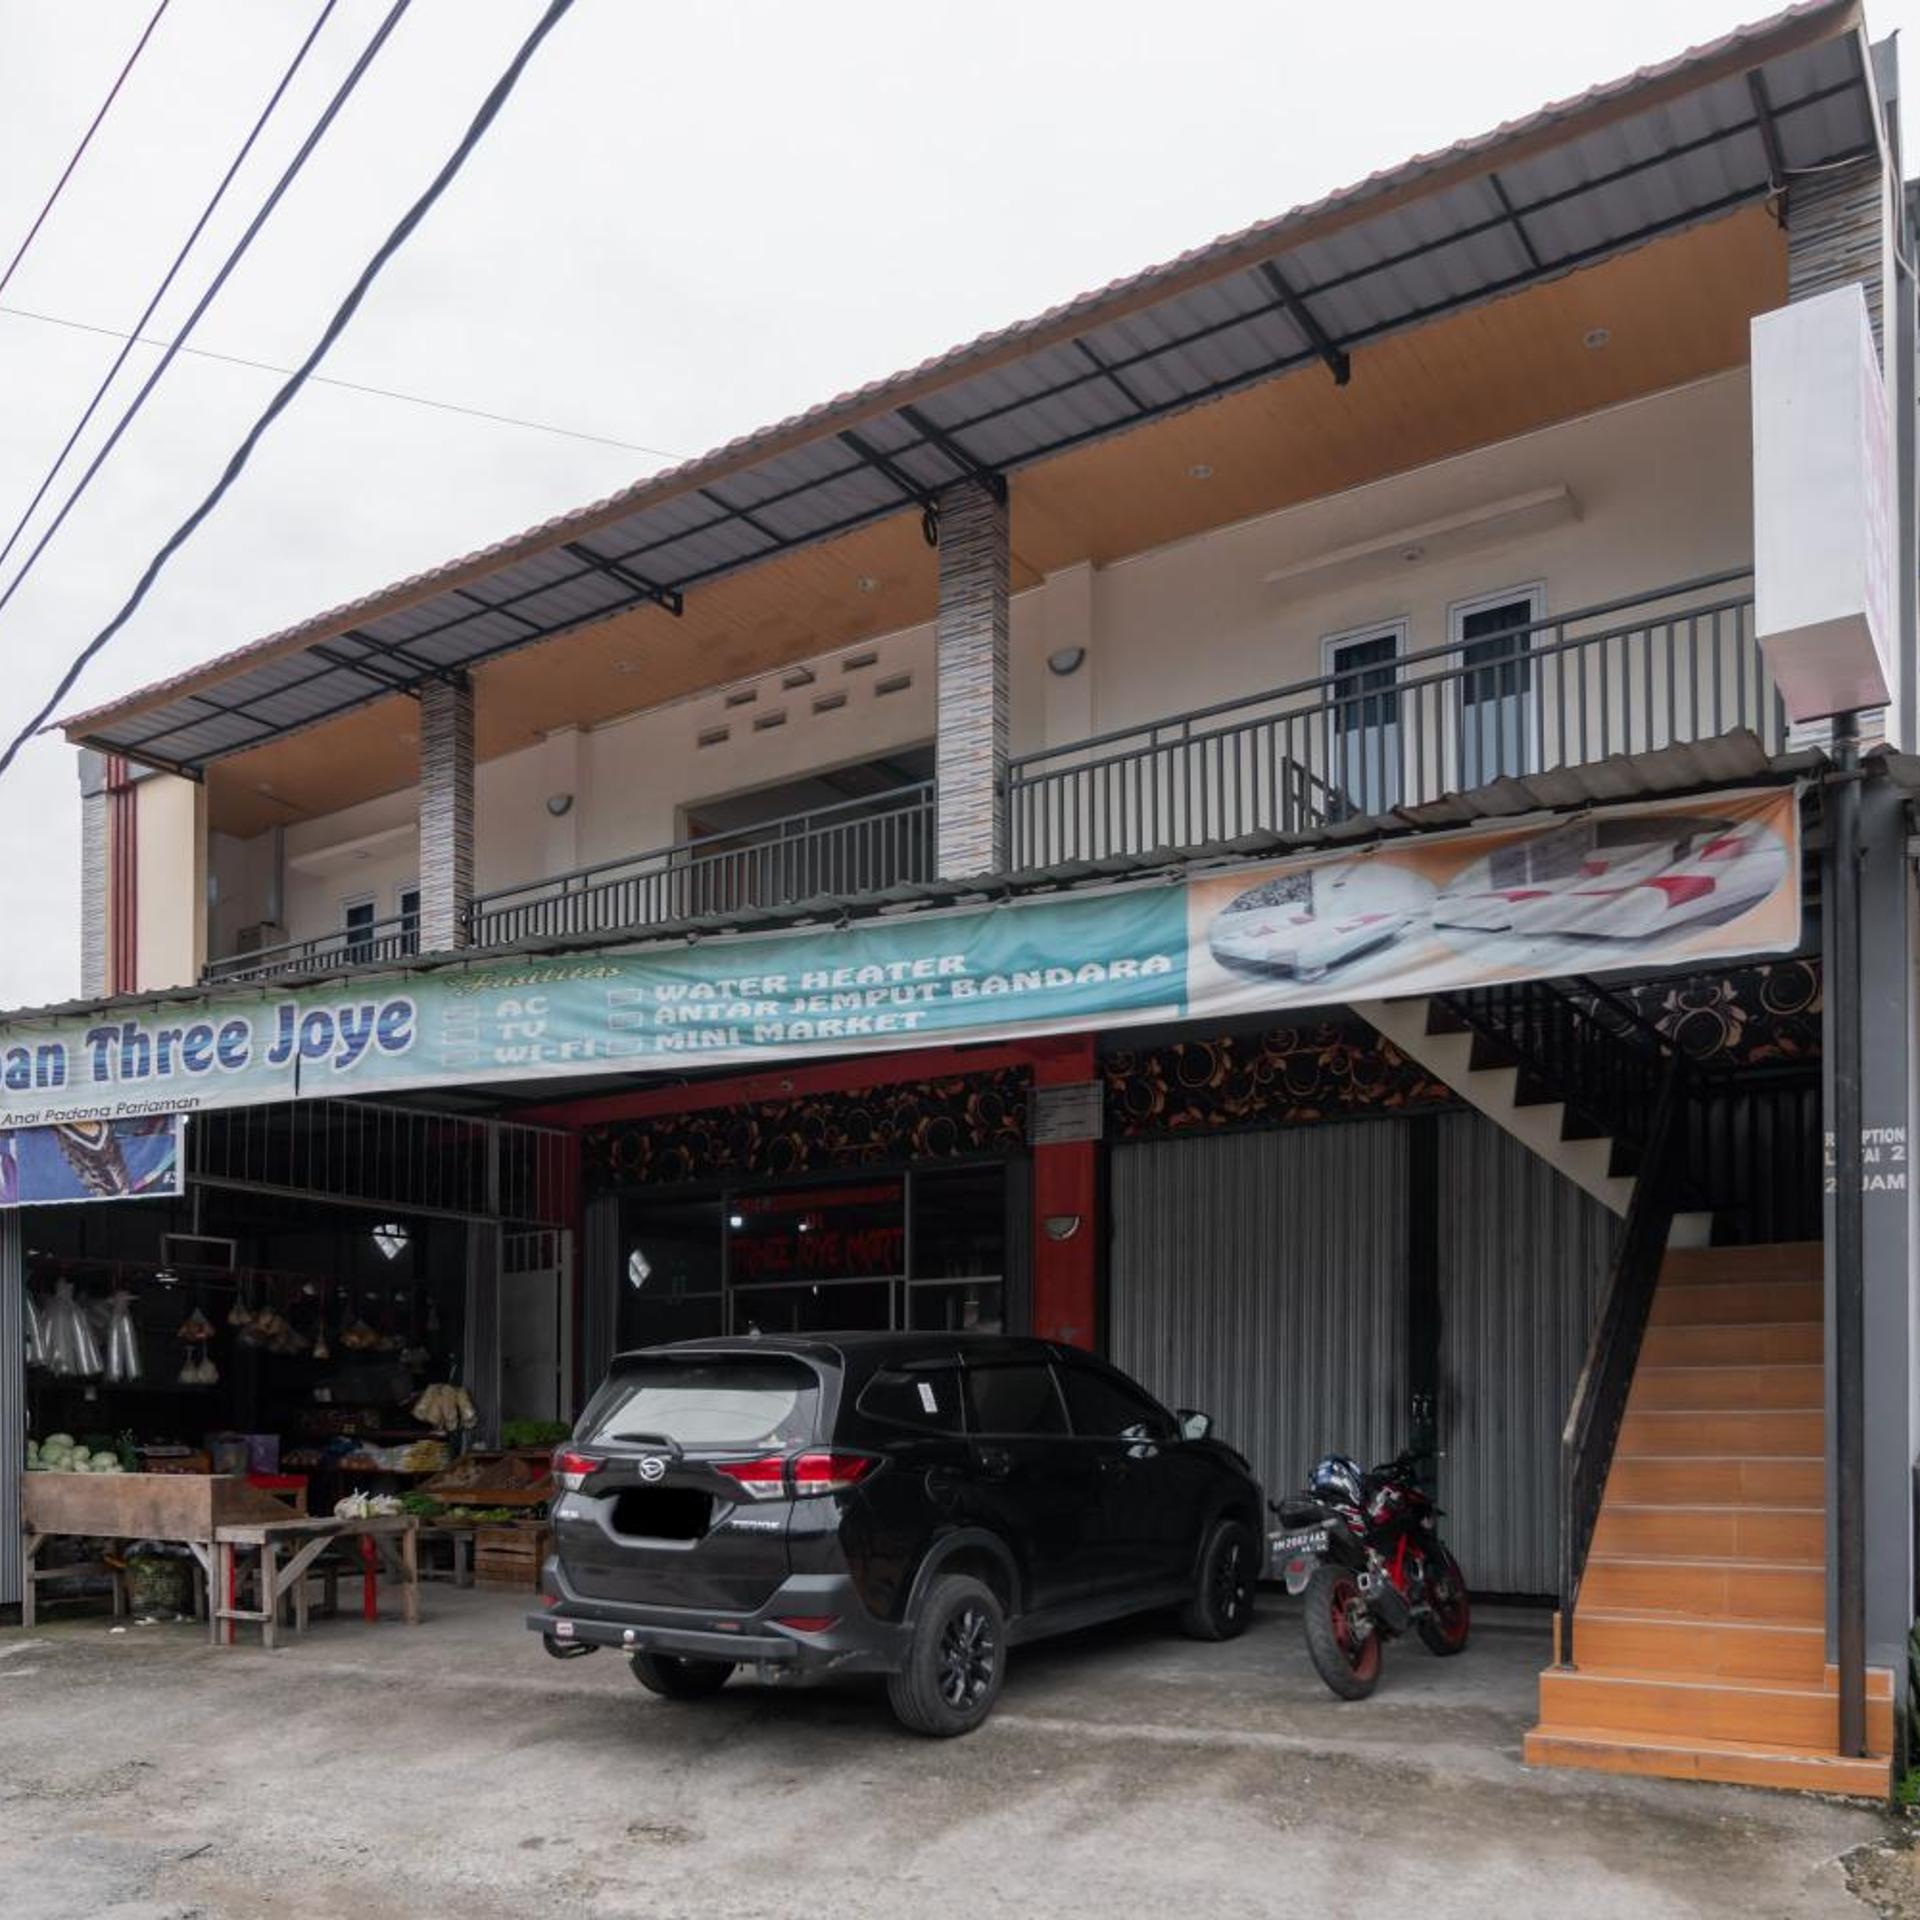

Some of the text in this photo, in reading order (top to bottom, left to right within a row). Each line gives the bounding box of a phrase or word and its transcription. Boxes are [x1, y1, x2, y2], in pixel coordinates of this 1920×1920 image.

[655, 955, 967, 1001] WATER HEATER
[654, 955, 1172, 1025] ANTAR JEMPUT BANDARA
[496, 996, 549, 1018] AC
[496, 1020, 549, 1040] TV
[654, 1011, 927, 1050] MINI MARKET
[0, 999, 413, 1090] an Three Joye
[117, 1096, 200, 1115] Pariaman
[1824, 1127, 1906, 1147] RPTION
[1861, 1173, 1906, 1191] JAM
